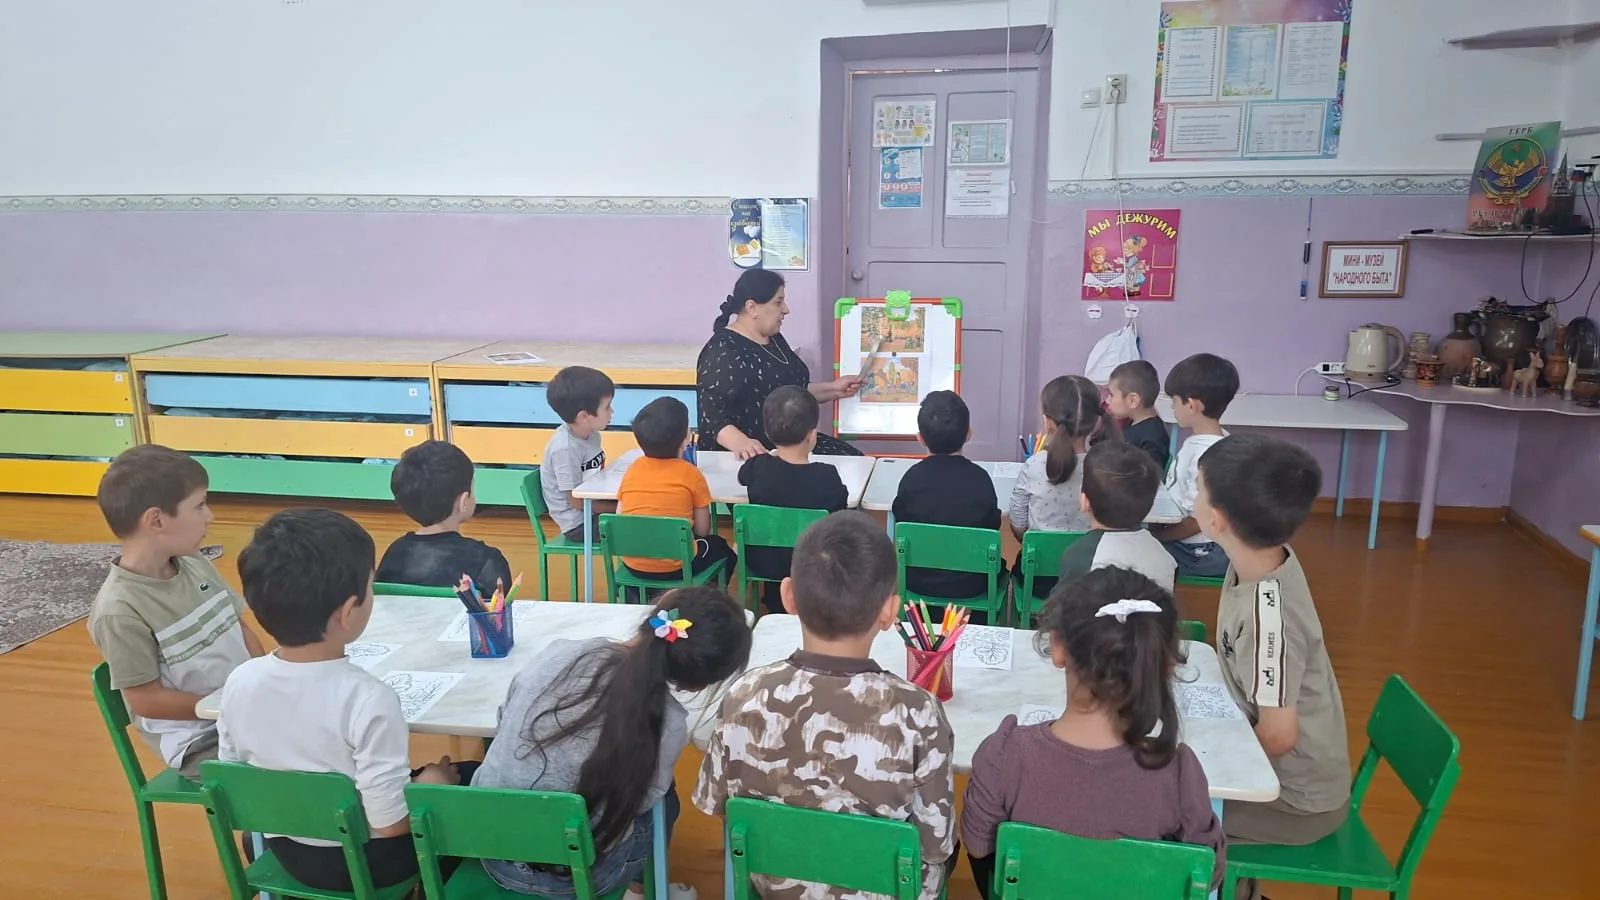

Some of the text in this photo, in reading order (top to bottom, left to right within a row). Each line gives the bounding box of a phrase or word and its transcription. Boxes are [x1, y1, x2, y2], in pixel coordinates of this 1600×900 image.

[1508, 126, 1534, 136] ГЕРБ
[1087, 213, 1177, 239] МЫ ДЕЖУРИМ
